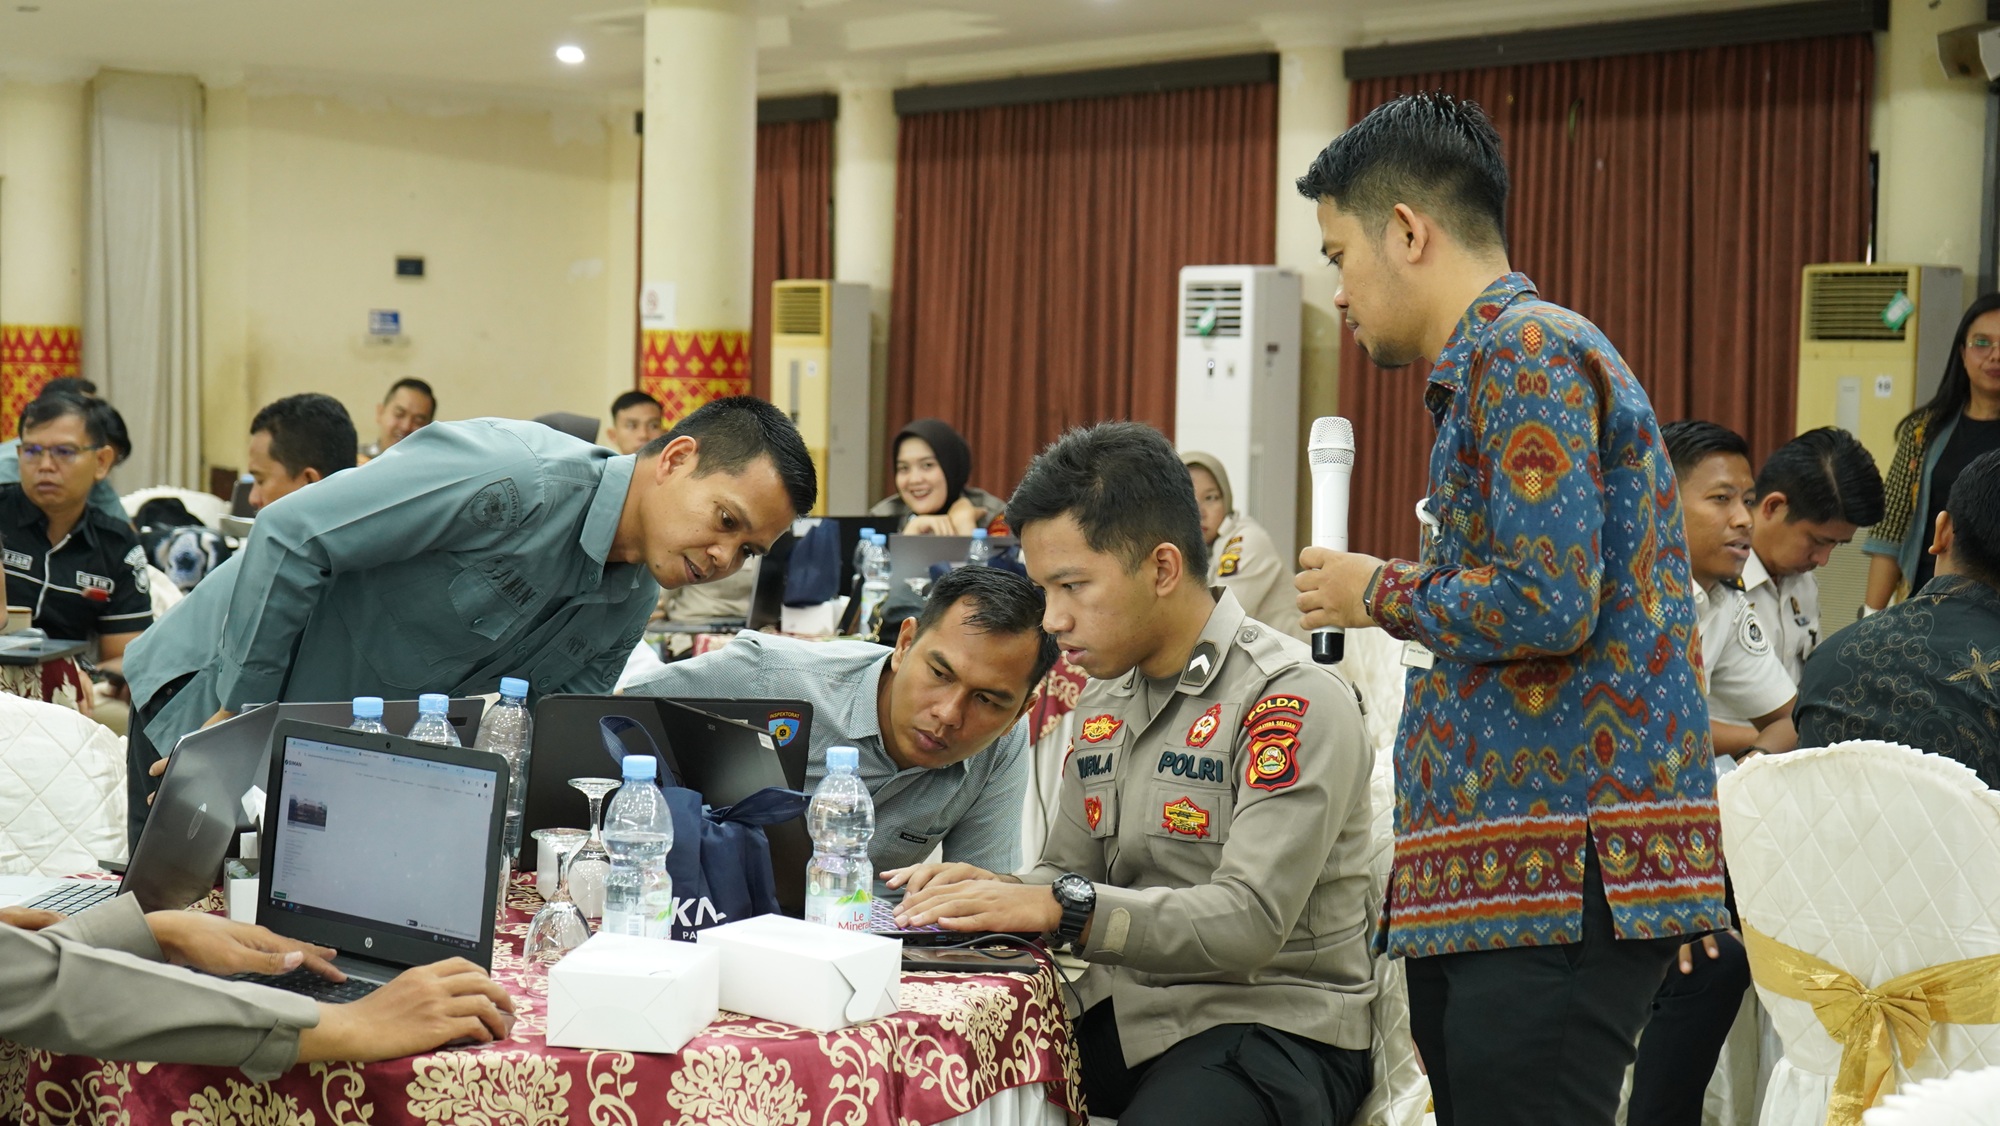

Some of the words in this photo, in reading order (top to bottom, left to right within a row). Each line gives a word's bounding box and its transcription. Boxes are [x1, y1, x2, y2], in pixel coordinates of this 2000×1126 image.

[1158, 751, 1223, 783] POLRI
[853, 910, 865, 922] Le
[682, 931, 697, 940] PA
